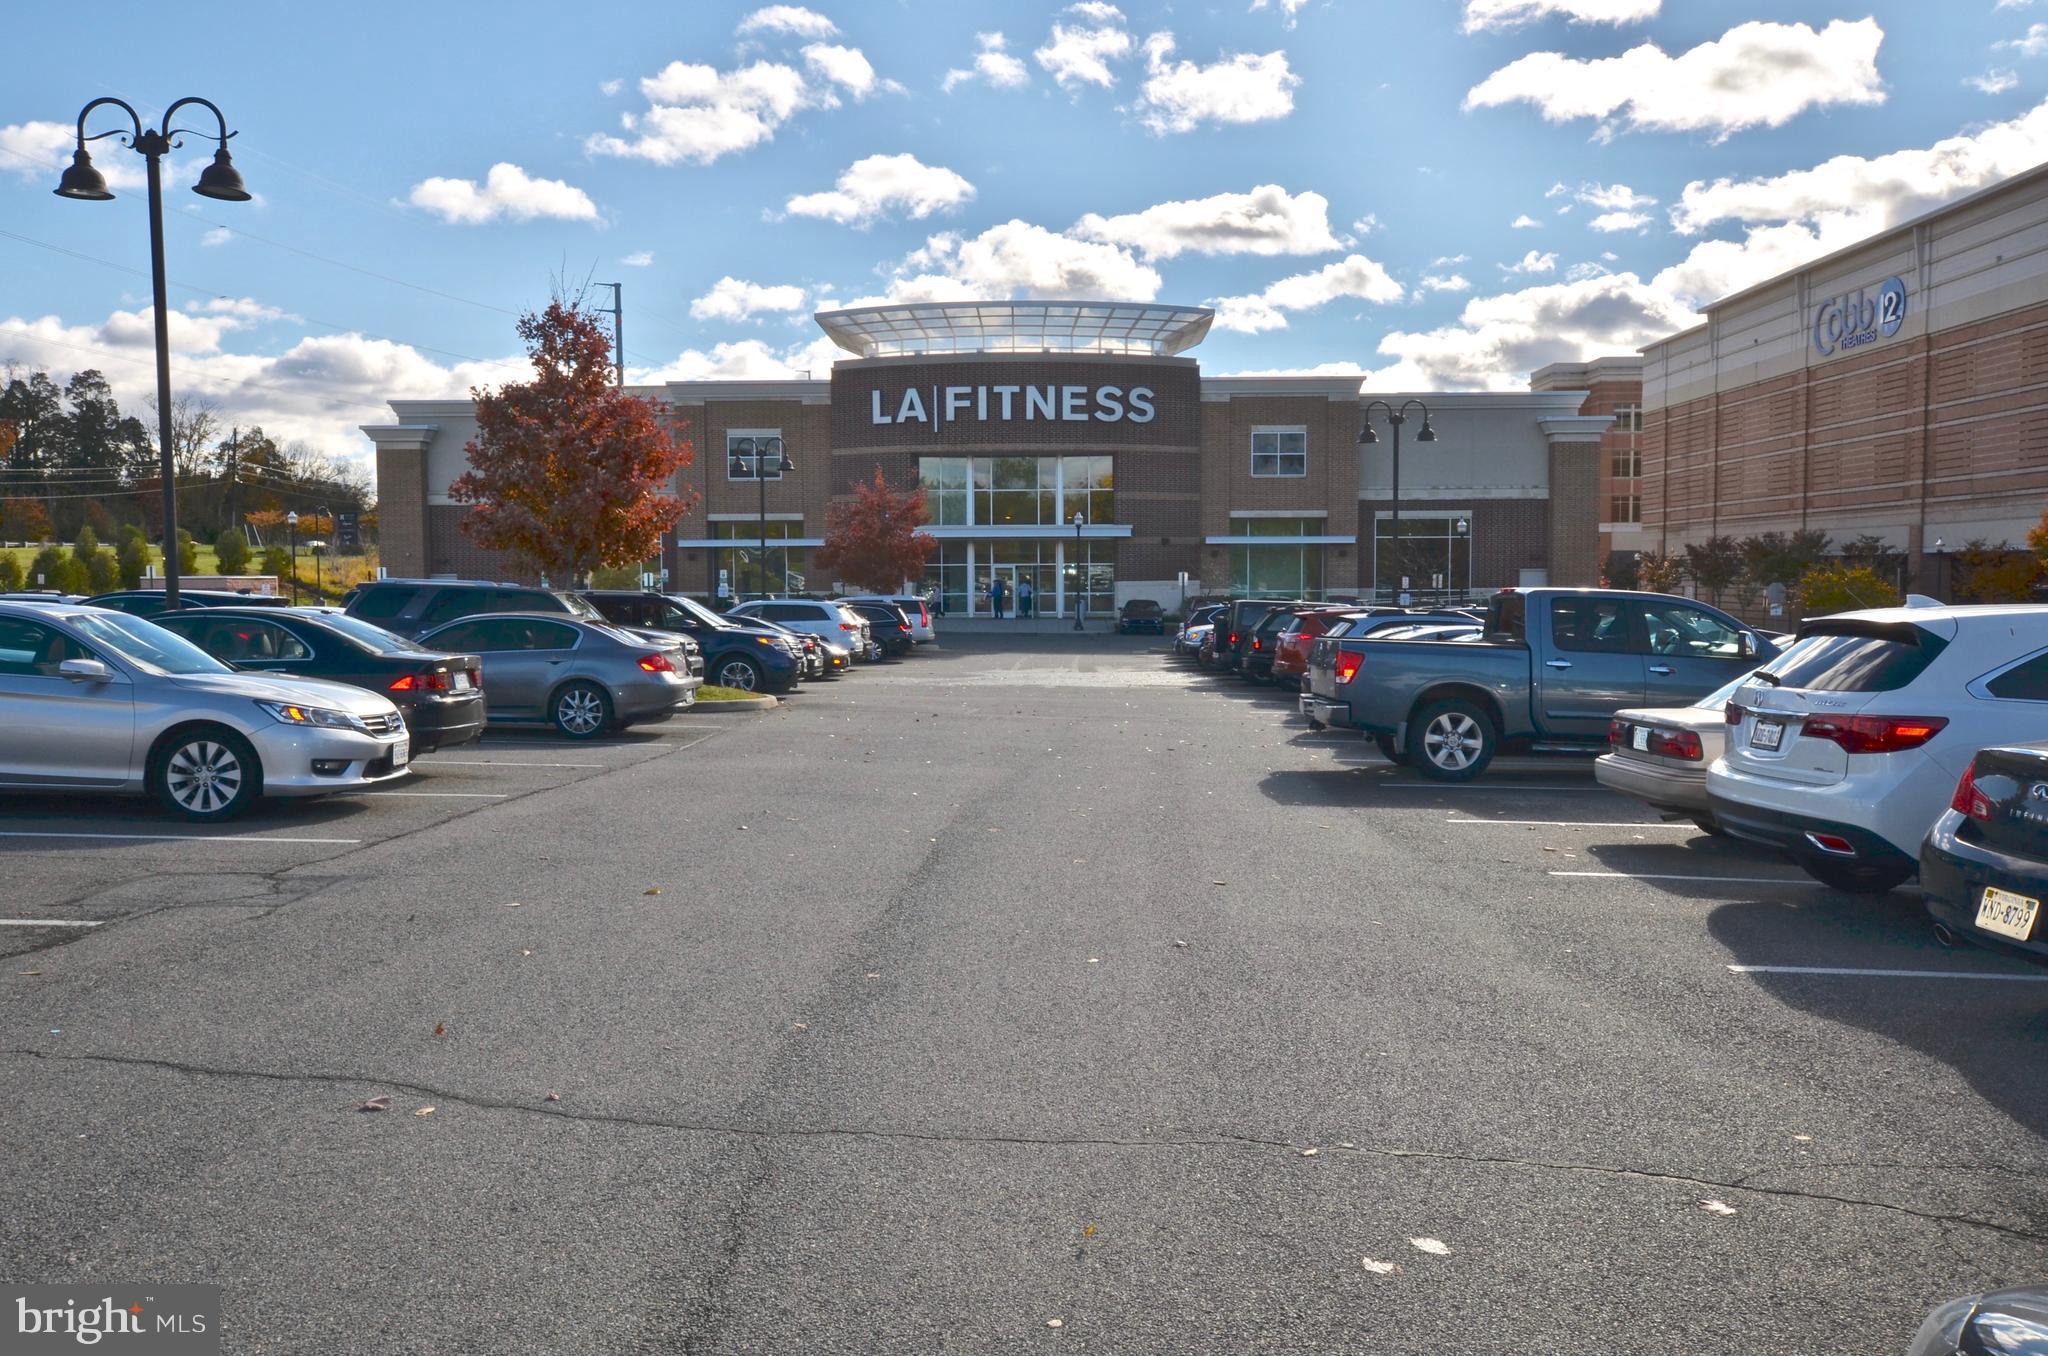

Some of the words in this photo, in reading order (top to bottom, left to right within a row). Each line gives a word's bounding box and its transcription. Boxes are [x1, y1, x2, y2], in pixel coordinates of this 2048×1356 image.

[1813, 288, 1875, 356] Cobb
[1879, 291, 1900, 324] 12
[872, 387, 928, 425] LA
[945, 385, 1155, 423] FITNESS
